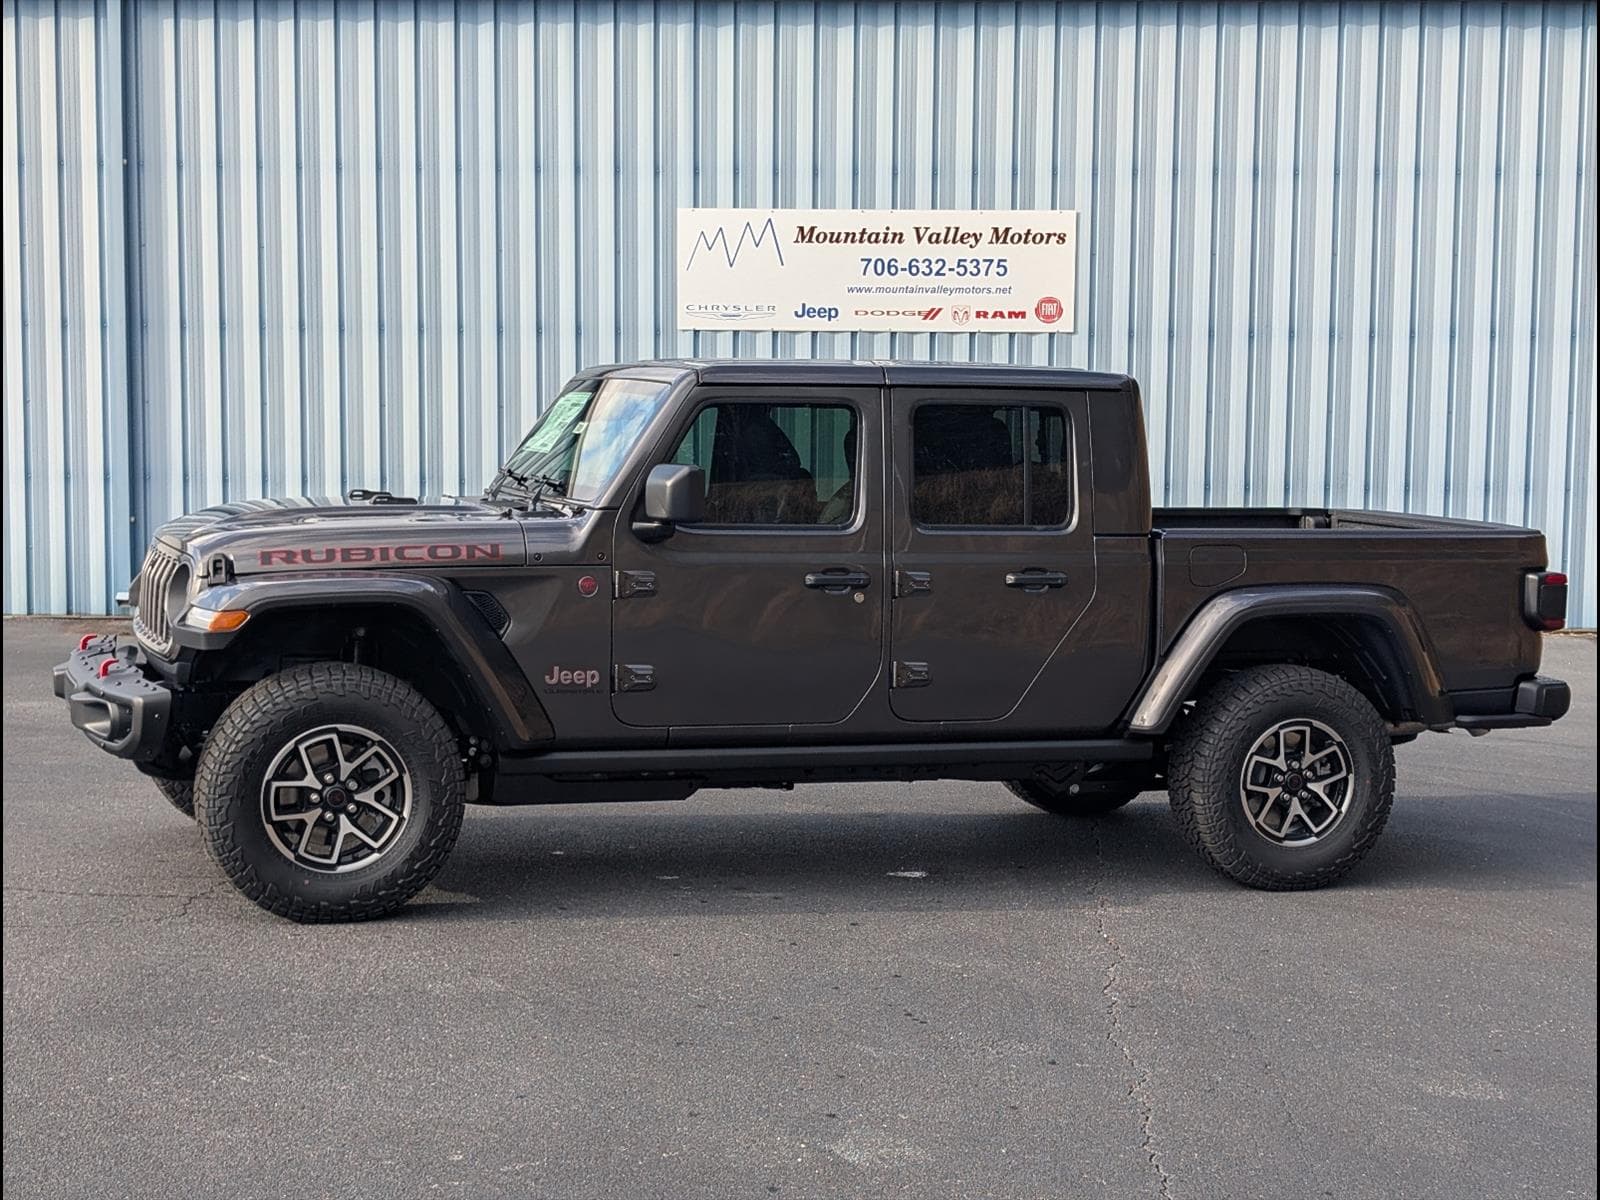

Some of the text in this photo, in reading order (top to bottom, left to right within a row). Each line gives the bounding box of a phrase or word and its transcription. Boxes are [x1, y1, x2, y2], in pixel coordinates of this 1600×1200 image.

[793, 226, 1067, 248] Mountain Valley Motors
[860, 258, 1008, 277] 706-632-5375
[847, 285, 1012, 296] www.mountainvalleymotors.net
[686, 304, 776, 312] CHRYSLER
[794, 303, 839, 321] Jeep
[854, 310, 928, 318] DODGE
[975, 310, 1027, 319] RAM
[1041, 302, 1058, 316] FIAT
[259, 544, 503, 566] RUBICON
[544, 666, 600, 688] Jeep
